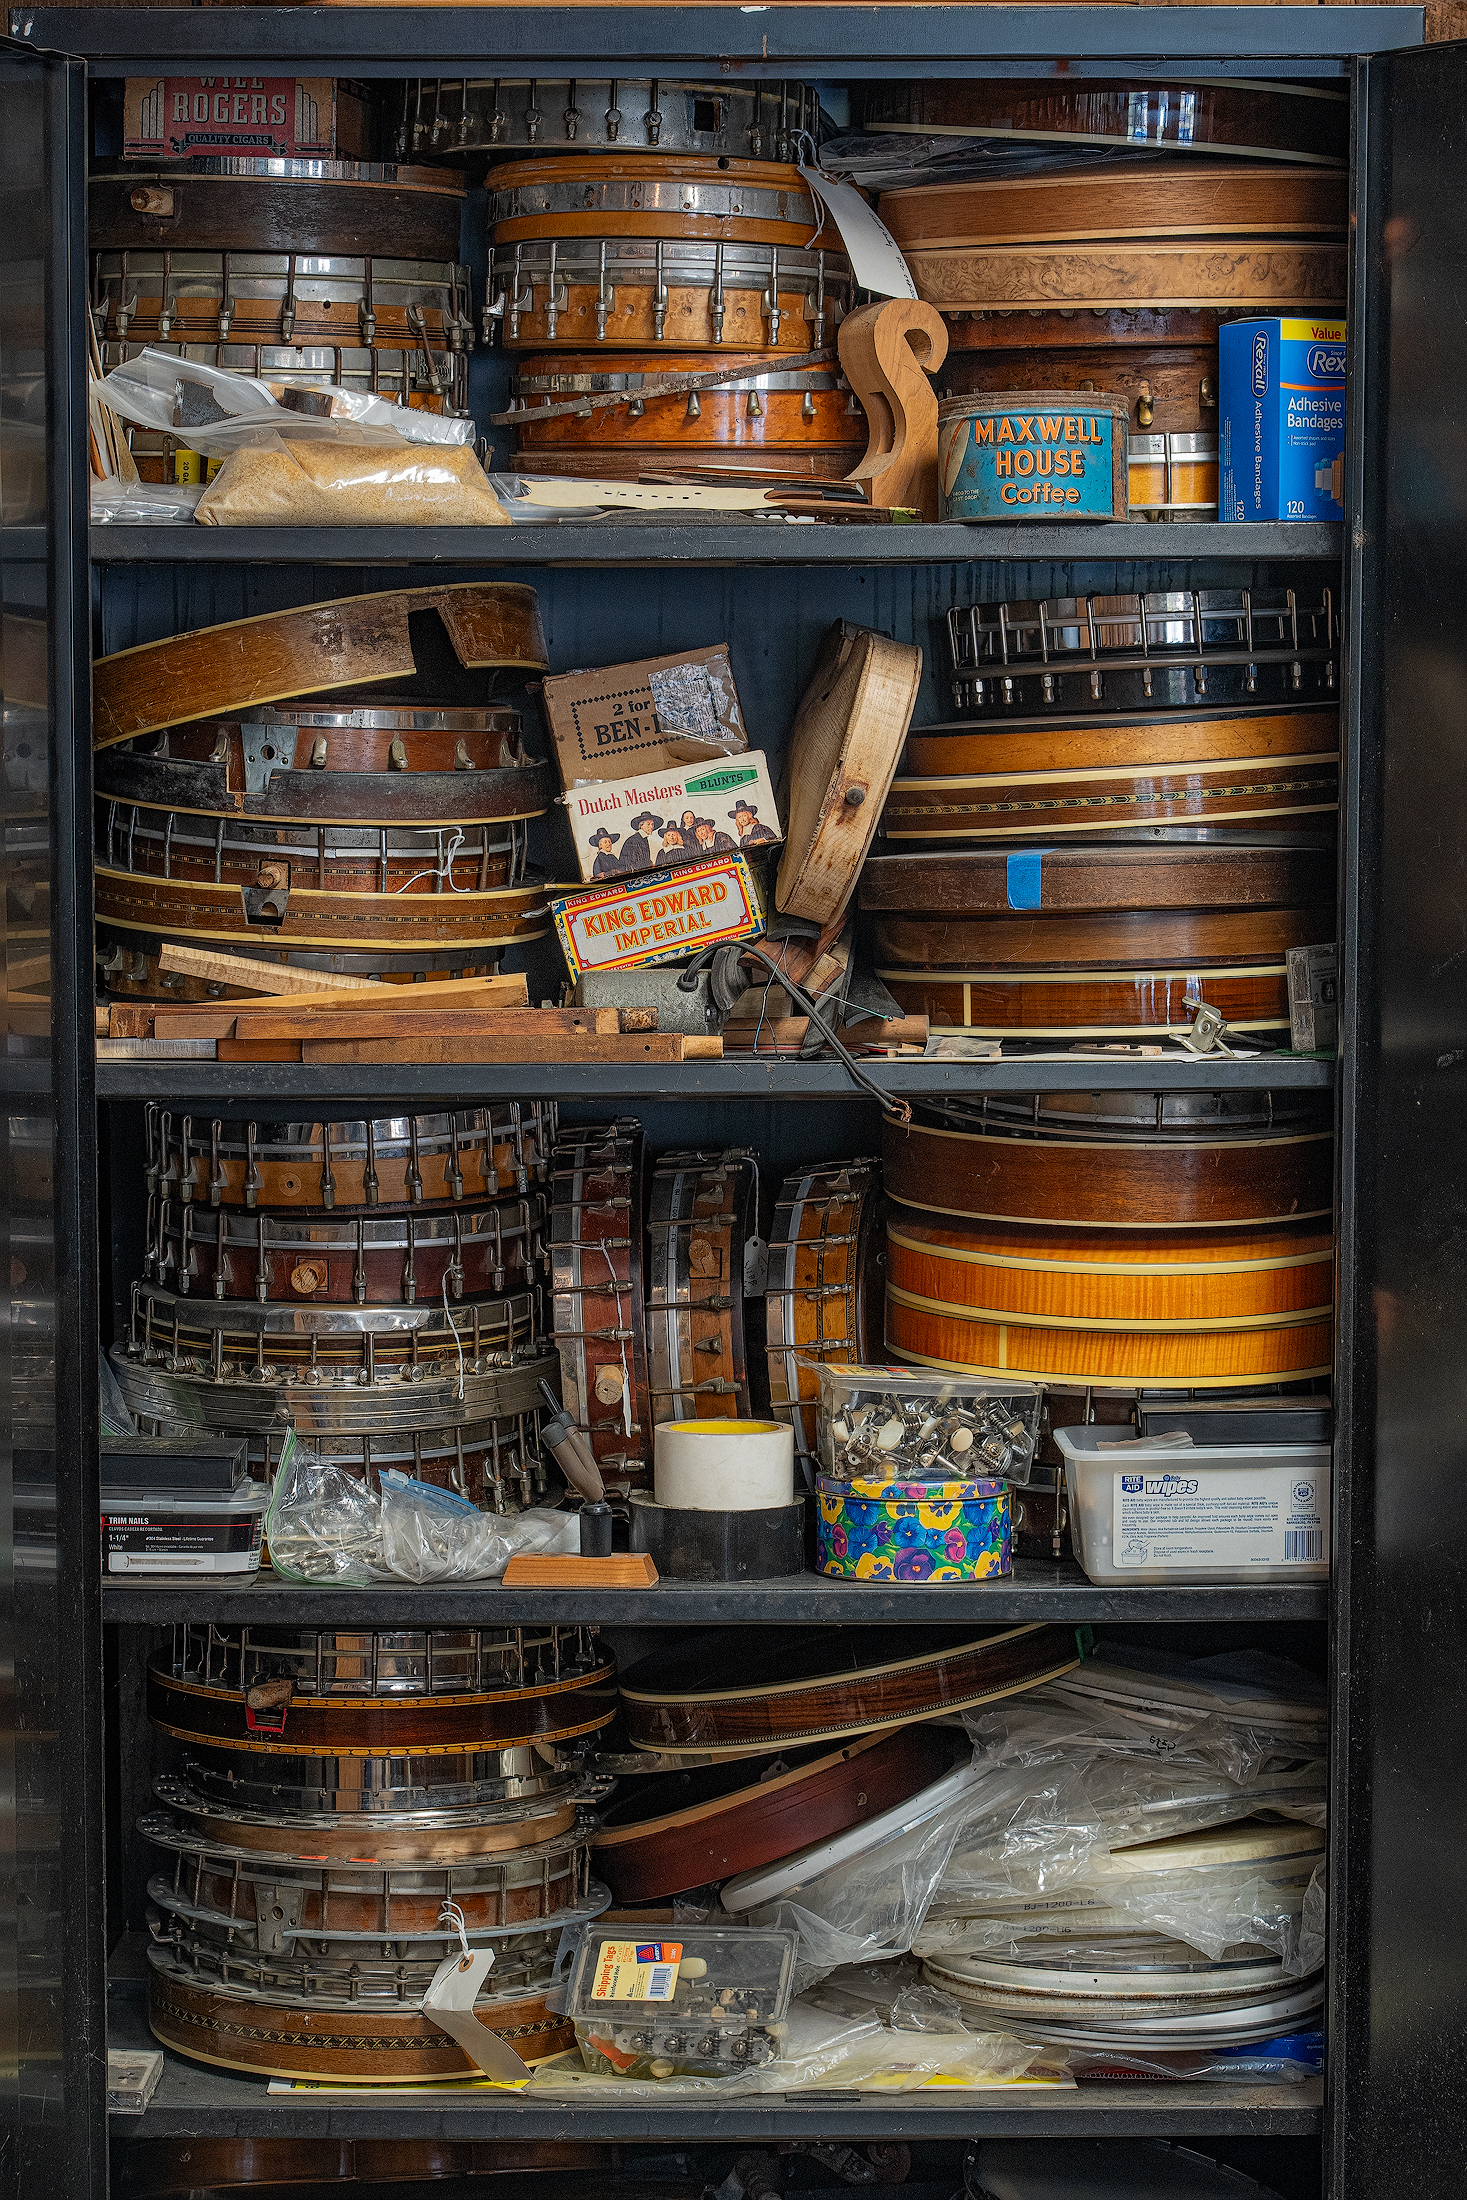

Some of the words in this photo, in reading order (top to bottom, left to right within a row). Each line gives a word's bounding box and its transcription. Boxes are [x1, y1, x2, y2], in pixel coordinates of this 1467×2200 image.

[172, 92, 286, 125] ROGERS
[188, 134, 231, 145] QUALITY
[232, 134, 270, 146] CIGARS
[1310, 326, 1342, 340] Value
[1255, 336, 1266, 390] Rexall
[1288, 396, 1342, 412] Adhesive
[974, 416, 1103, 447] MAXWELL
[1254, 400, 1262, 453] Adhesive
[1288, 413, 1343, 432] Bandages
[995, 450, 1086, 478] HOUSE
[1254, 456, 1262, 510] Bandages
[1001, 482, 1082, 505] Coffee
[1236, 500, 1245, 520] 120
[1287, 501, 1304, 514] 120
[612, 704, 624, 716] 2
[628, 700, 650, 712] for
[700, 773, 744, 790] BLUNTS
[578, 792, 622, 816] Dutch
[624, 784, 683, 807] Masters
[673, 867, 694, 878] KING
[695, 858, 730, 872] EDWARD
[568, 896, 588, 907] KING
[590, 887, 624, 902] EDWARD
[582, 906, 636, 939] KING
[637, 882, 728, 922] EDWARD
[614, 911, 712, 952] IMPERIAL
[1146, 1477, 1198, 1497] wipes
[108, 1517, 128, 1525] TRIM
[128, 1517, 149, 1525] NAILS
[603, 1946, 616, 1963] Tags
[596, 1964, 614, 1997] Shipping
